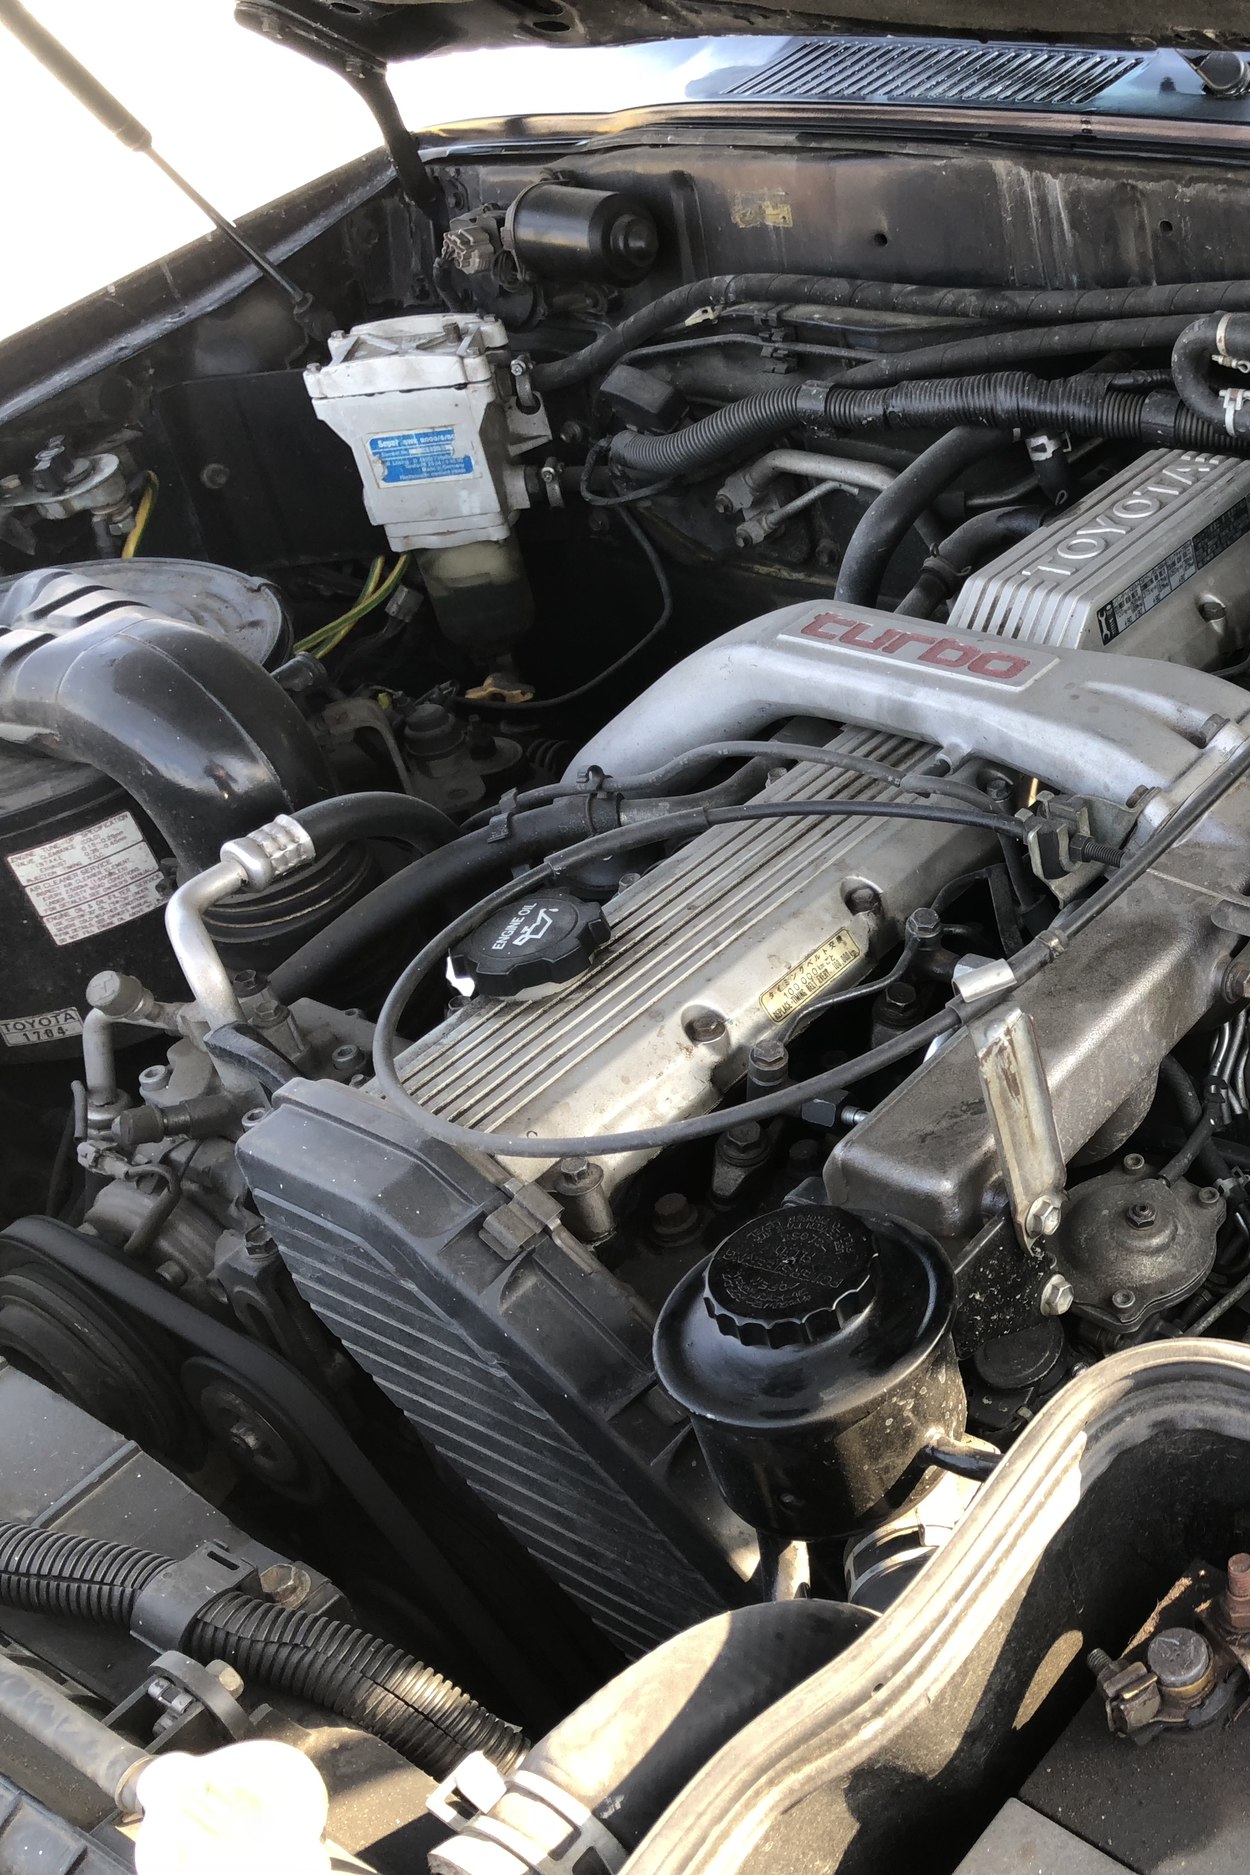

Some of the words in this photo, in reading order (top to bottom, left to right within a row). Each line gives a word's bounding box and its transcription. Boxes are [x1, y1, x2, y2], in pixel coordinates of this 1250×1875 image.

[1021, 466, 1211, 576] TOYOTA
[801, 612, 1031, 679] turbo
[79, 813, 128, 837] SPECIFICATION
[29, 885, 42, 894] AIR
[43, 871, 79, 889] CLEANER
[80, 858, 112, 875] SERVICE
[133, 872, 161, 889] SERVICE
[491, 916, 526, 950] ENGINE
[517, 903, 537, 917] OIL
[3, 1012, 76, 1032] TOYOTA
